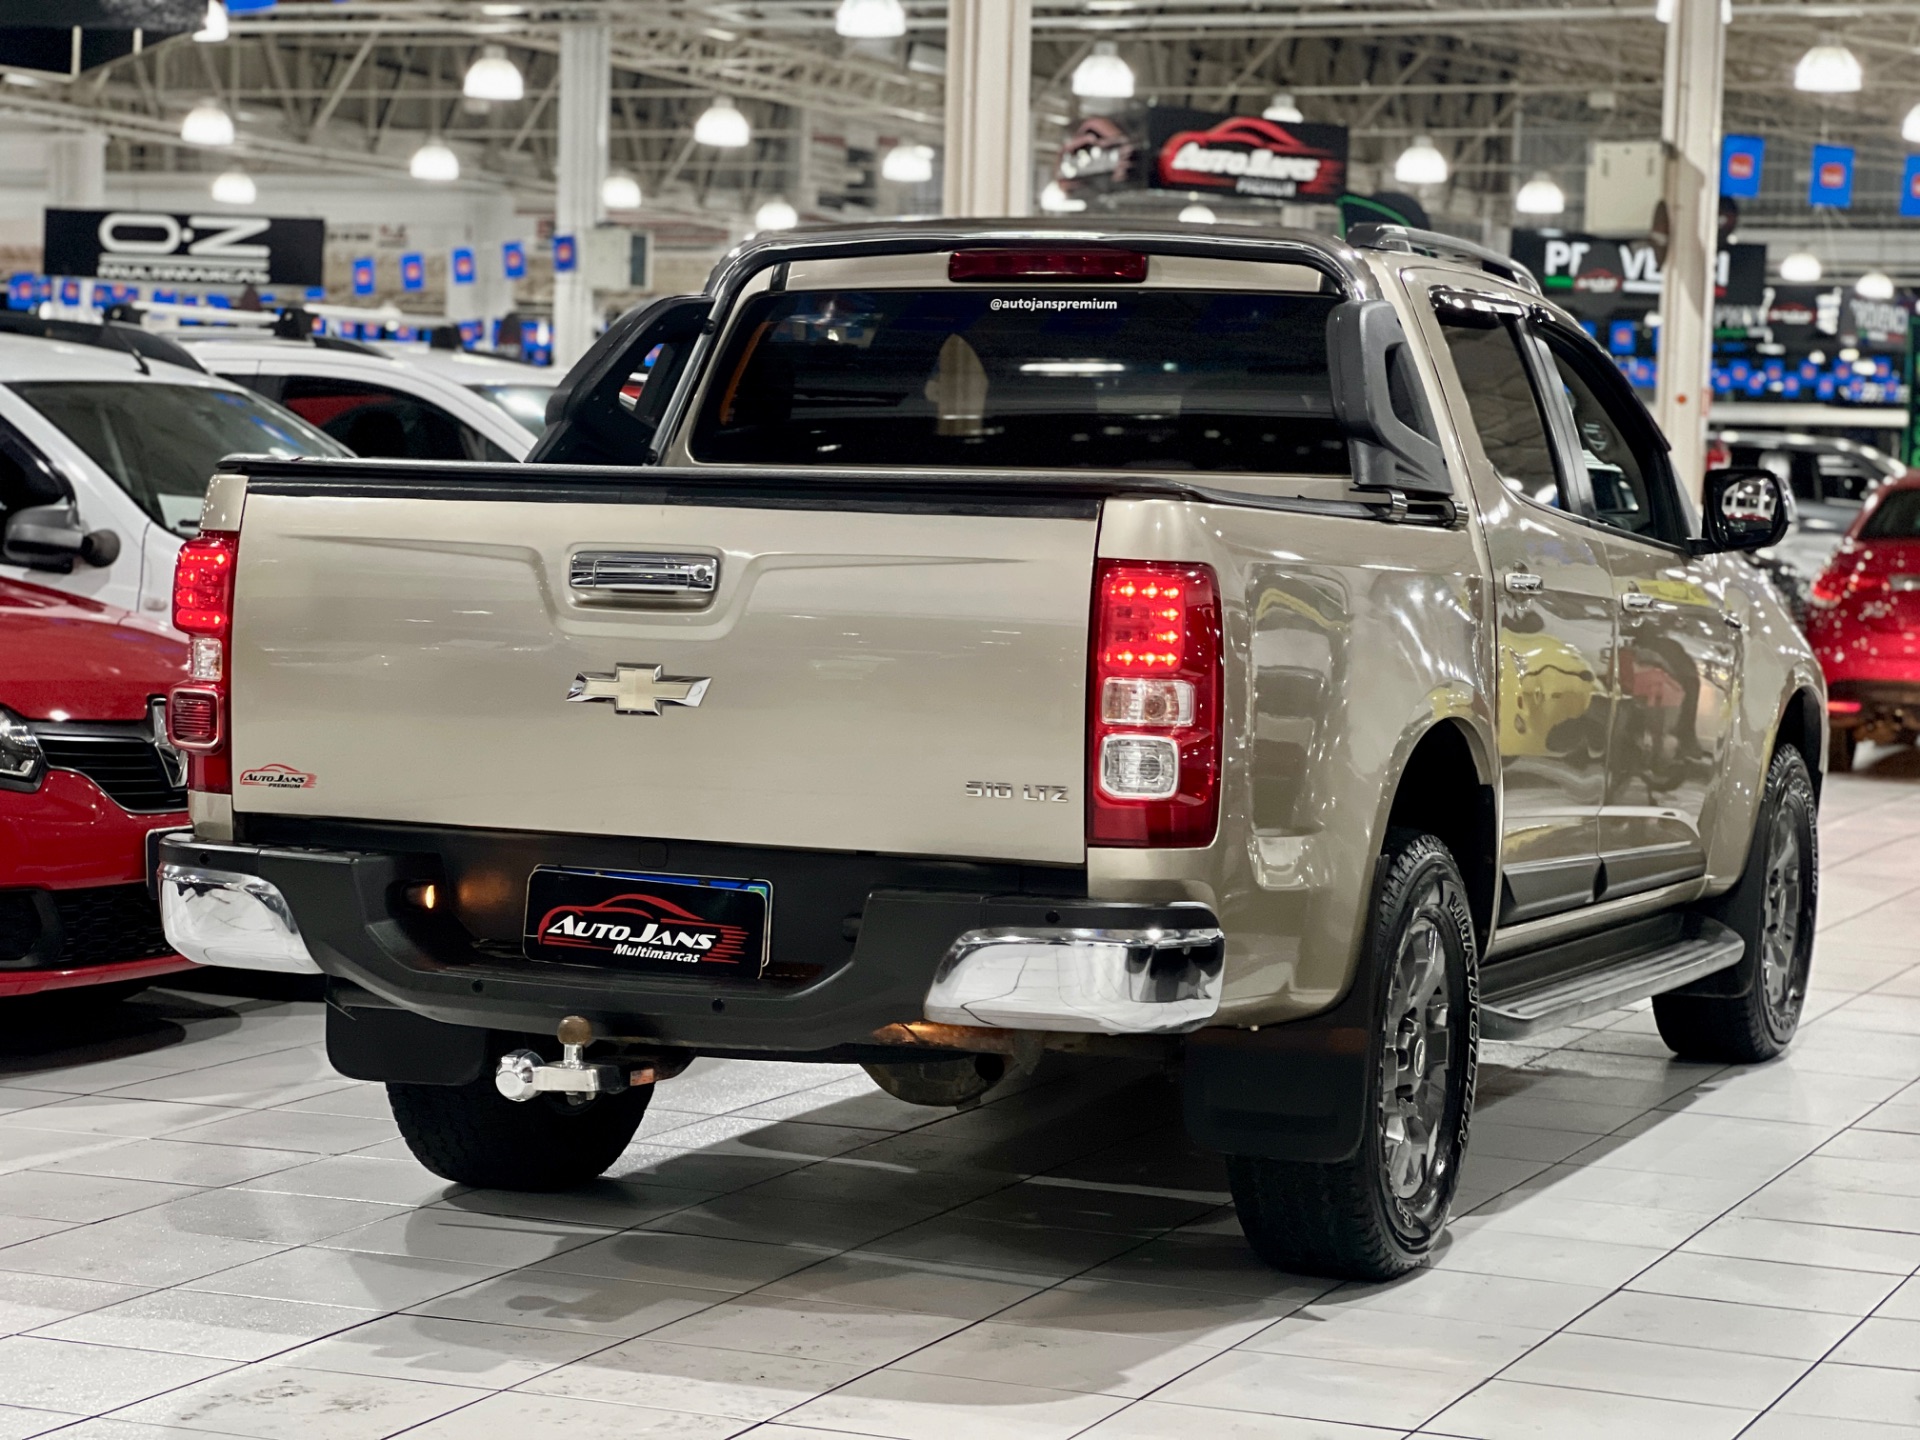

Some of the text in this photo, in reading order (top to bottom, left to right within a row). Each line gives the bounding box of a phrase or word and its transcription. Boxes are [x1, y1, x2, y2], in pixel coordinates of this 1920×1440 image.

[989, 297, 1118, 312] @autojanspremium
[244, 773, 306, 783] AUTO JANS
[965, 781, 1068, 803] S10 LTZ
[546, 914, 717, 950] AUTO JANS
[613, 943, 701, 963] Multimarcas
